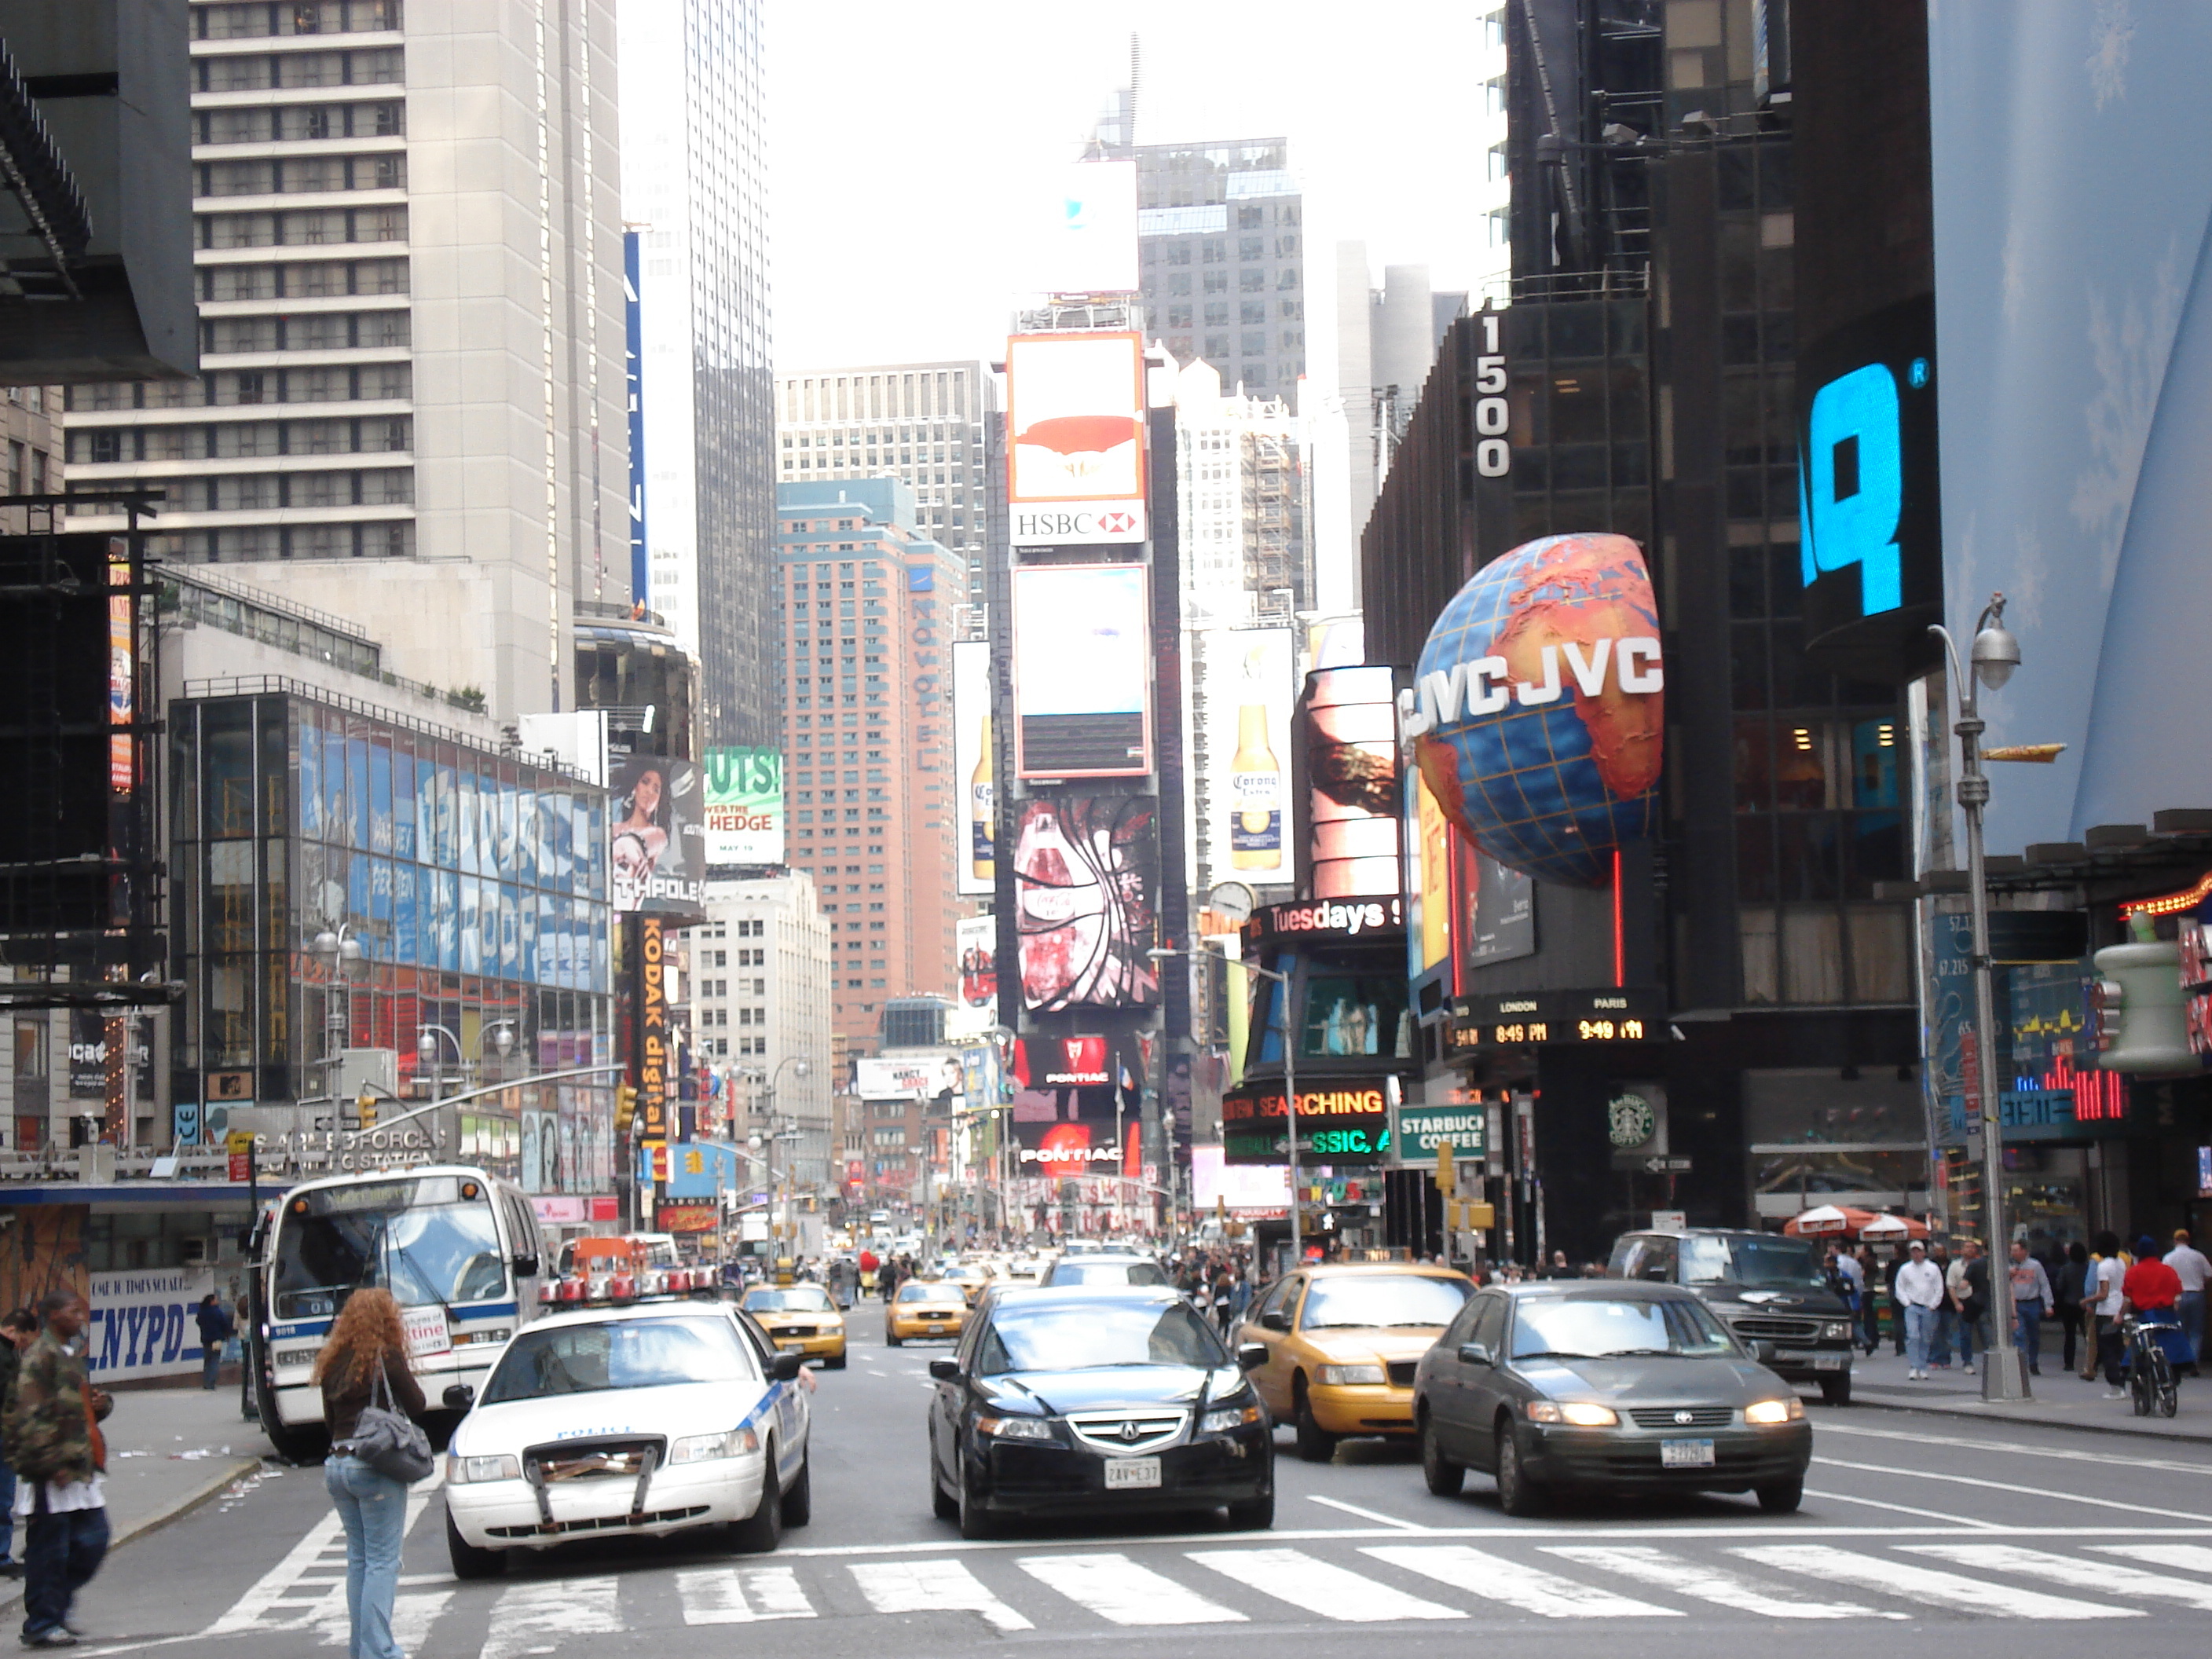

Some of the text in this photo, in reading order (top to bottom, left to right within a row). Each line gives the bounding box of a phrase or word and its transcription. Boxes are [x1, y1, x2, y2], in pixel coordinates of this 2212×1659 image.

[1476, 316, 1510, 478] 1500
[1018, 513, 1092, 536] HSBC
[1516, 636, 1664, 706] JVC
[910, 599, 933, 772] NOVOTEL
[1233, 775, 1276, 789] Corona
[730, 805, 749, 815] THE
[709, 815, 772, 831] HEDGE
[1271, 899, 1385, 936] Tuesdays
[1500, 1000, 1537, 1013] LONDON
[1594, 998, 1628, 1009] PARIS
[643, 917, 666, 1134] KODAK digital
[1496, 1024, 1525, 1043] 8:49
[1529, 1022, 1547, 1042] PM
[892, 1069, 920, 1080] NANCY
[1046, 1071, 1109, 1084] PONTIAC
[1259, 1090, 1383, 1117] SEARCHING
[359, 1129, 446, 1149] FORCES
[1419, 1131, 1482, 1149] COFFEE
[1020, 1148, 1123, 1163] PONTIAC
[98, 1304, 185, 1369] NYPD
